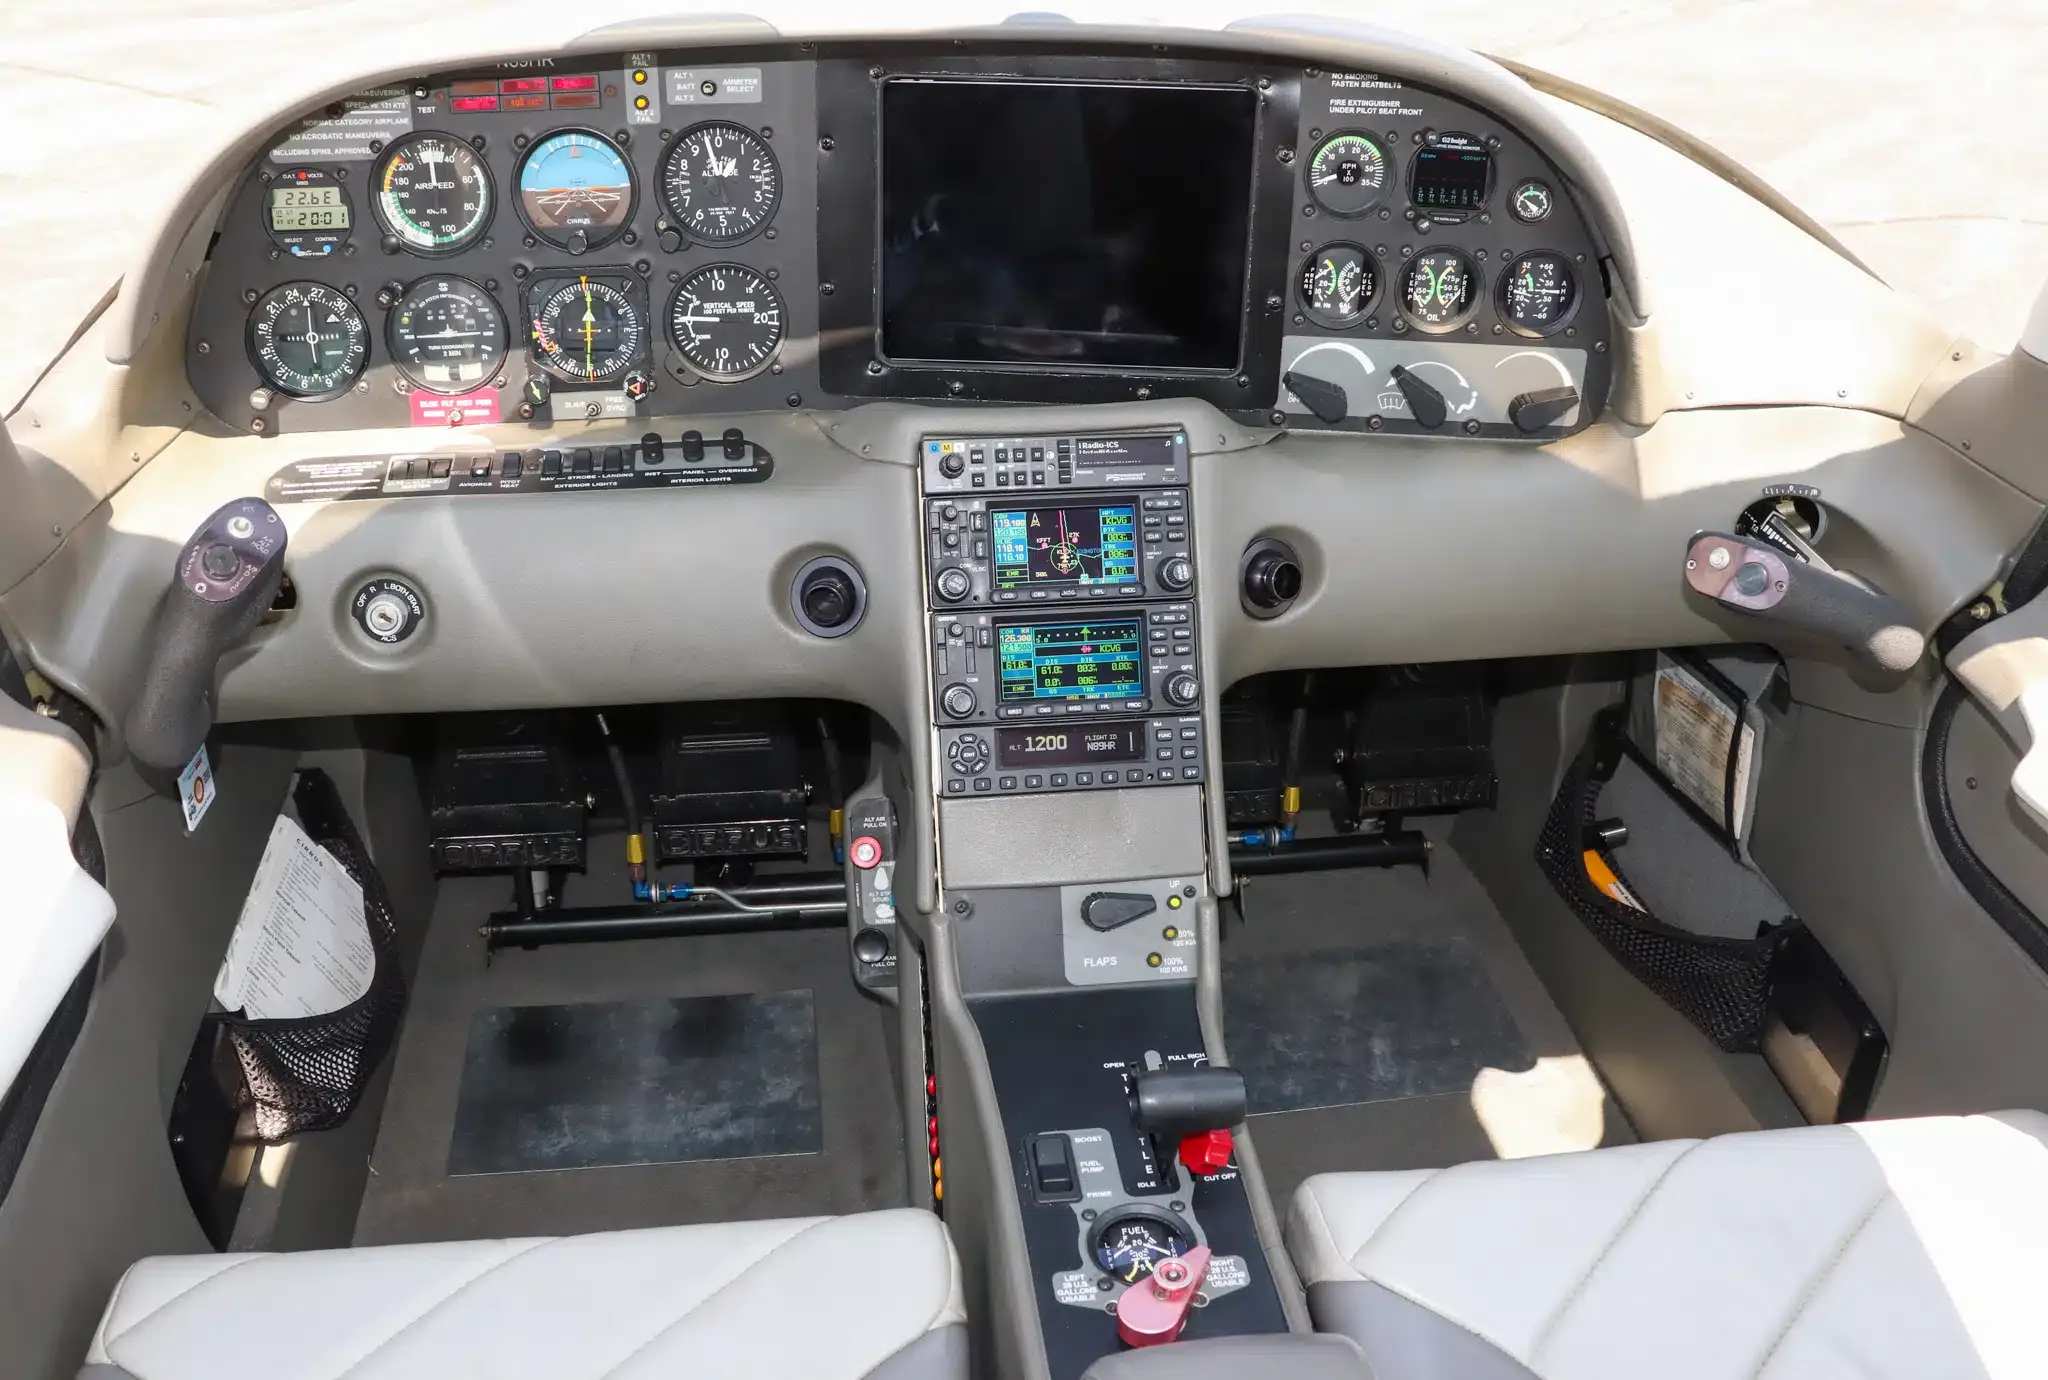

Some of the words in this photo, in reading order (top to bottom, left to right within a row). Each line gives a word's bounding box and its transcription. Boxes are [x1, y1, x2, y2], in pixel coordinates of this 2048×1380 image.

[1361, 81, 1402, 89] SEATBELTS
[1348, 100, 1401, 108] EXTINGUISHER
[417, 106, 436, 114] TEST
[335, 118, 373, 127] CATEGORY
[375, 118, 410, 126] AIRPLANE
[301, 132, 344, 141] ACROBATIC
[715, 136, 723, 148] 0
[691, 145, 700, 157] 9
[444, 156, 455, 164] 40
[680, 159, 688, 171] 8
[753, 159, 761, 171] 2
[398, 163, 414, 171] 200
[394, 177, 410, 186] 180
[462, 176, 473, 184] 60
[683, 196, 691, 208] 7
[754, 191, 763, 203] 3
[464, 203, 475, 211] 80
[696, 209, 704, 221] 6
[742, 208, 751, 219] 4
[719, 216, 728, 227] 5
[441, 225, 457, 233] 100
[712, 279, 725, 291] 10
[285, 288, 300, 301] 24
[310, 288, 325, 298] 27
[266, 301, 280, 314] 21
[333, 298, 348, 312] 30
[703, 302, 731, 310] VERTICAL
[753, 313, 769, 324] 20
[1427, 314, 1441, 322] OIL
[258, 323, 270, 336] 18
[349, 318, 363, 332] 33
[261, 347, 273, 361] 15
[716, 348, 729, 360] 10
[276, 366, 290, 380] 12
[1105, 517, 1128, 525] KCVG
[357, 593, 368, 608] OFF
[369, 586, 377, 594] R
[390, 583, 410, 597] BOTH
[407, 594, 421, 616] START
[1099, 644, 1121, 653] KCVG
[1025, 735, 1068, 752] 1200
[1087, 741, 1116, 751] N89HR
[1084, 957, 1118, 968] FLAPS
[1168, 1054, 1187, 1062] FULL
[1221, 1173, 1237, 1181] OFF
[1122, 1226, 1148, 1235] FUEL
[1210, 1259, 1236, 1267] RIGHT
[1064, 1274, 1086, 1282] LEFT
[1207, 1272, 1247, 1281] GALLONS
[1212, 1278, 1246, 1288] USABLE
[1057, 1287, 1098, 1295] GALLONS
[1061, 1294, 1097, 1303] USABLE
